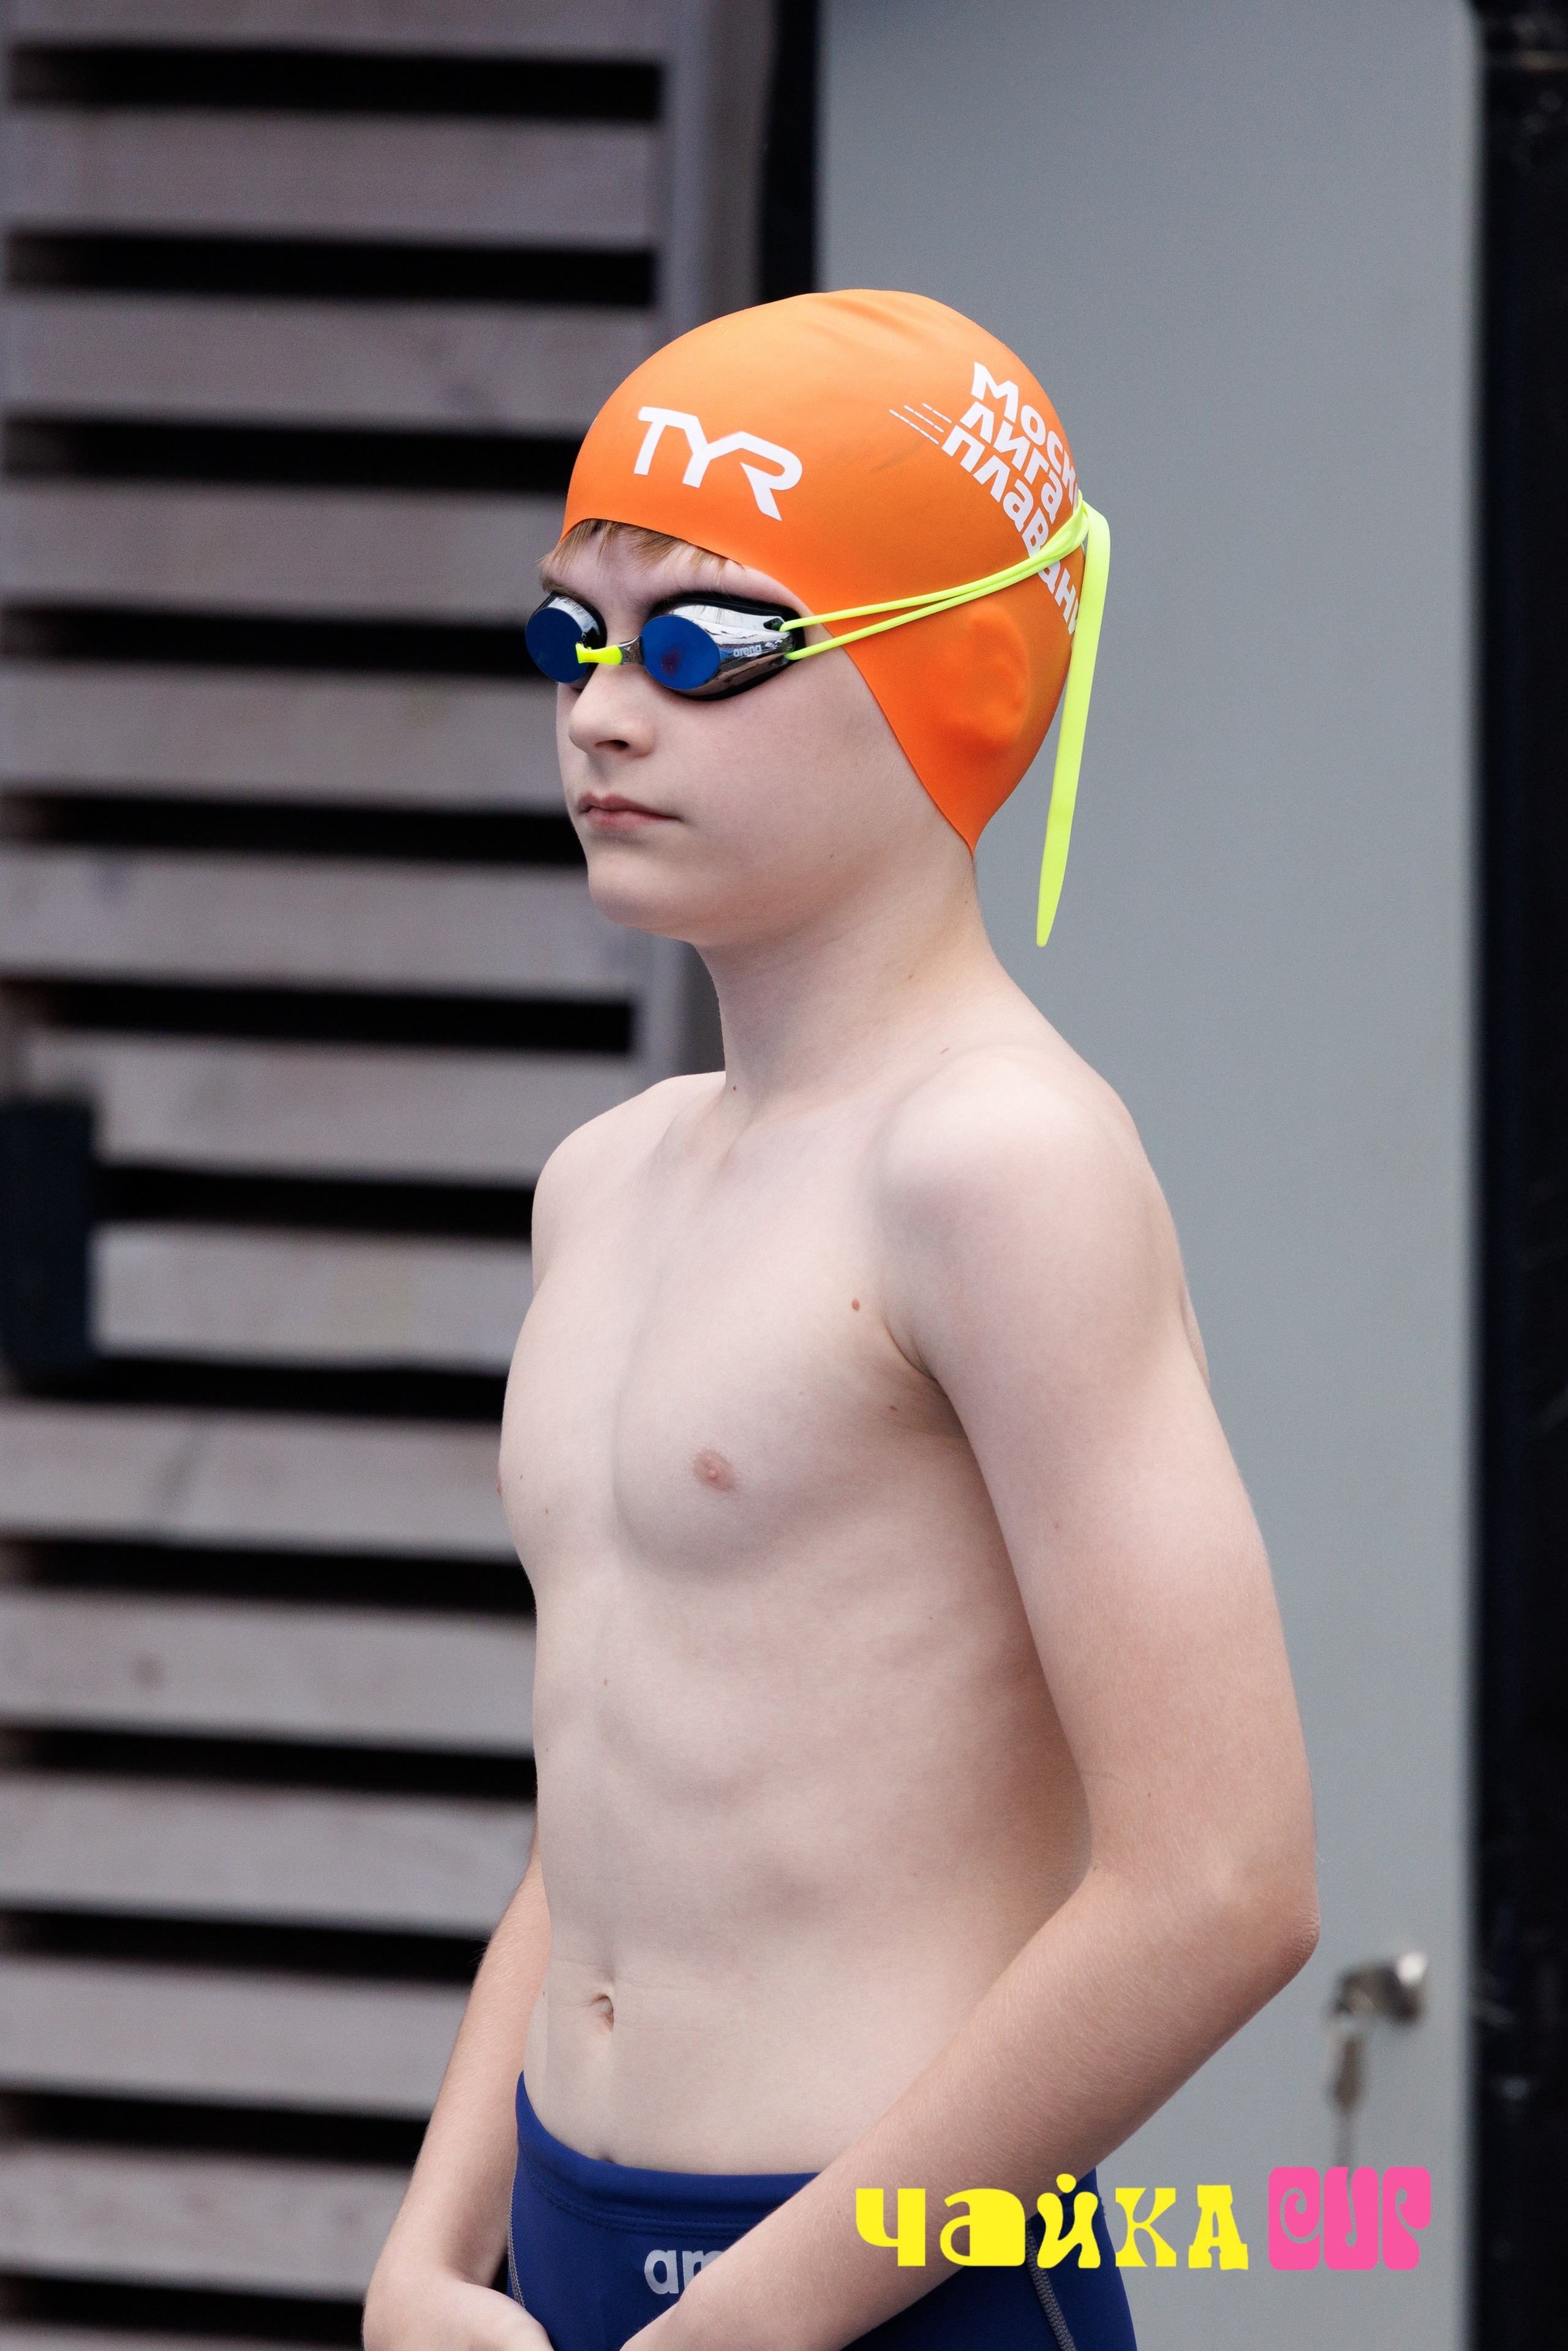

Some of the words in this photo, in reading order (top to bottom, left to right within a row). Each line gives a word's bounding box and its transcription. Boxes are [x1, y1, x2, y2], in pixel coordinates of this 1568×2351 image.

[633, 406, 802, 521] TYR
[971, 361, 1078, 515] Моск
[733, 644, 763, 657] arena
[644, 2249, 725, 2295] ar
